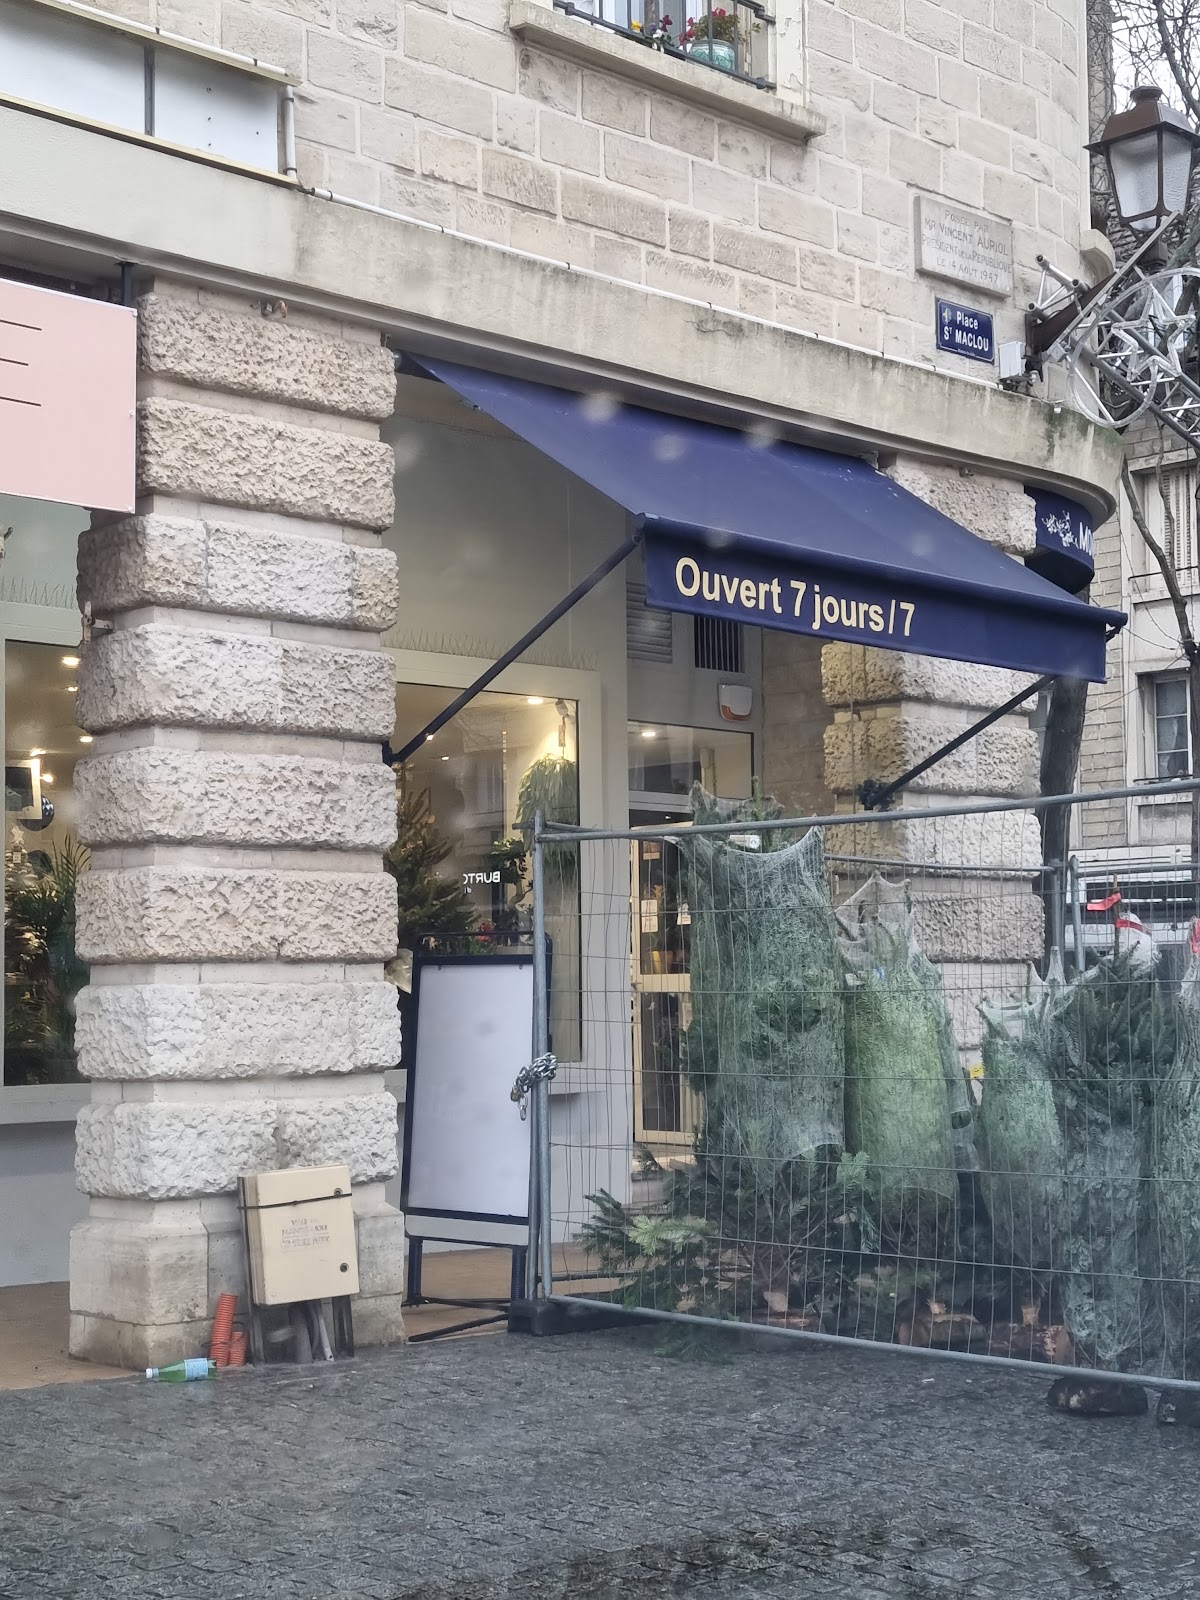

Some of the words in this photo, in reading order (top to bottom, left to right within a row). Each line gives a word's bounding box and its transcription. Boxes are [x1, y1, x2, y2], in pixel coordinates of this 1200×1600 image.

[939, 222, 974, 244] VINCENT
[977, 236, 1009, 256] AURIOL
[974, 221, 989, 233] PAR
[936, 257, 946, 267] LE
[948, 260, 957, 270] 14
[980, 270, 999, 284] 1947
[956, 311, 979, 330] Place
[955, 329, 989, 352] MACLOU
[675, 556, 783, 615] Ouvert
[790, 579, 807, 617] 7
